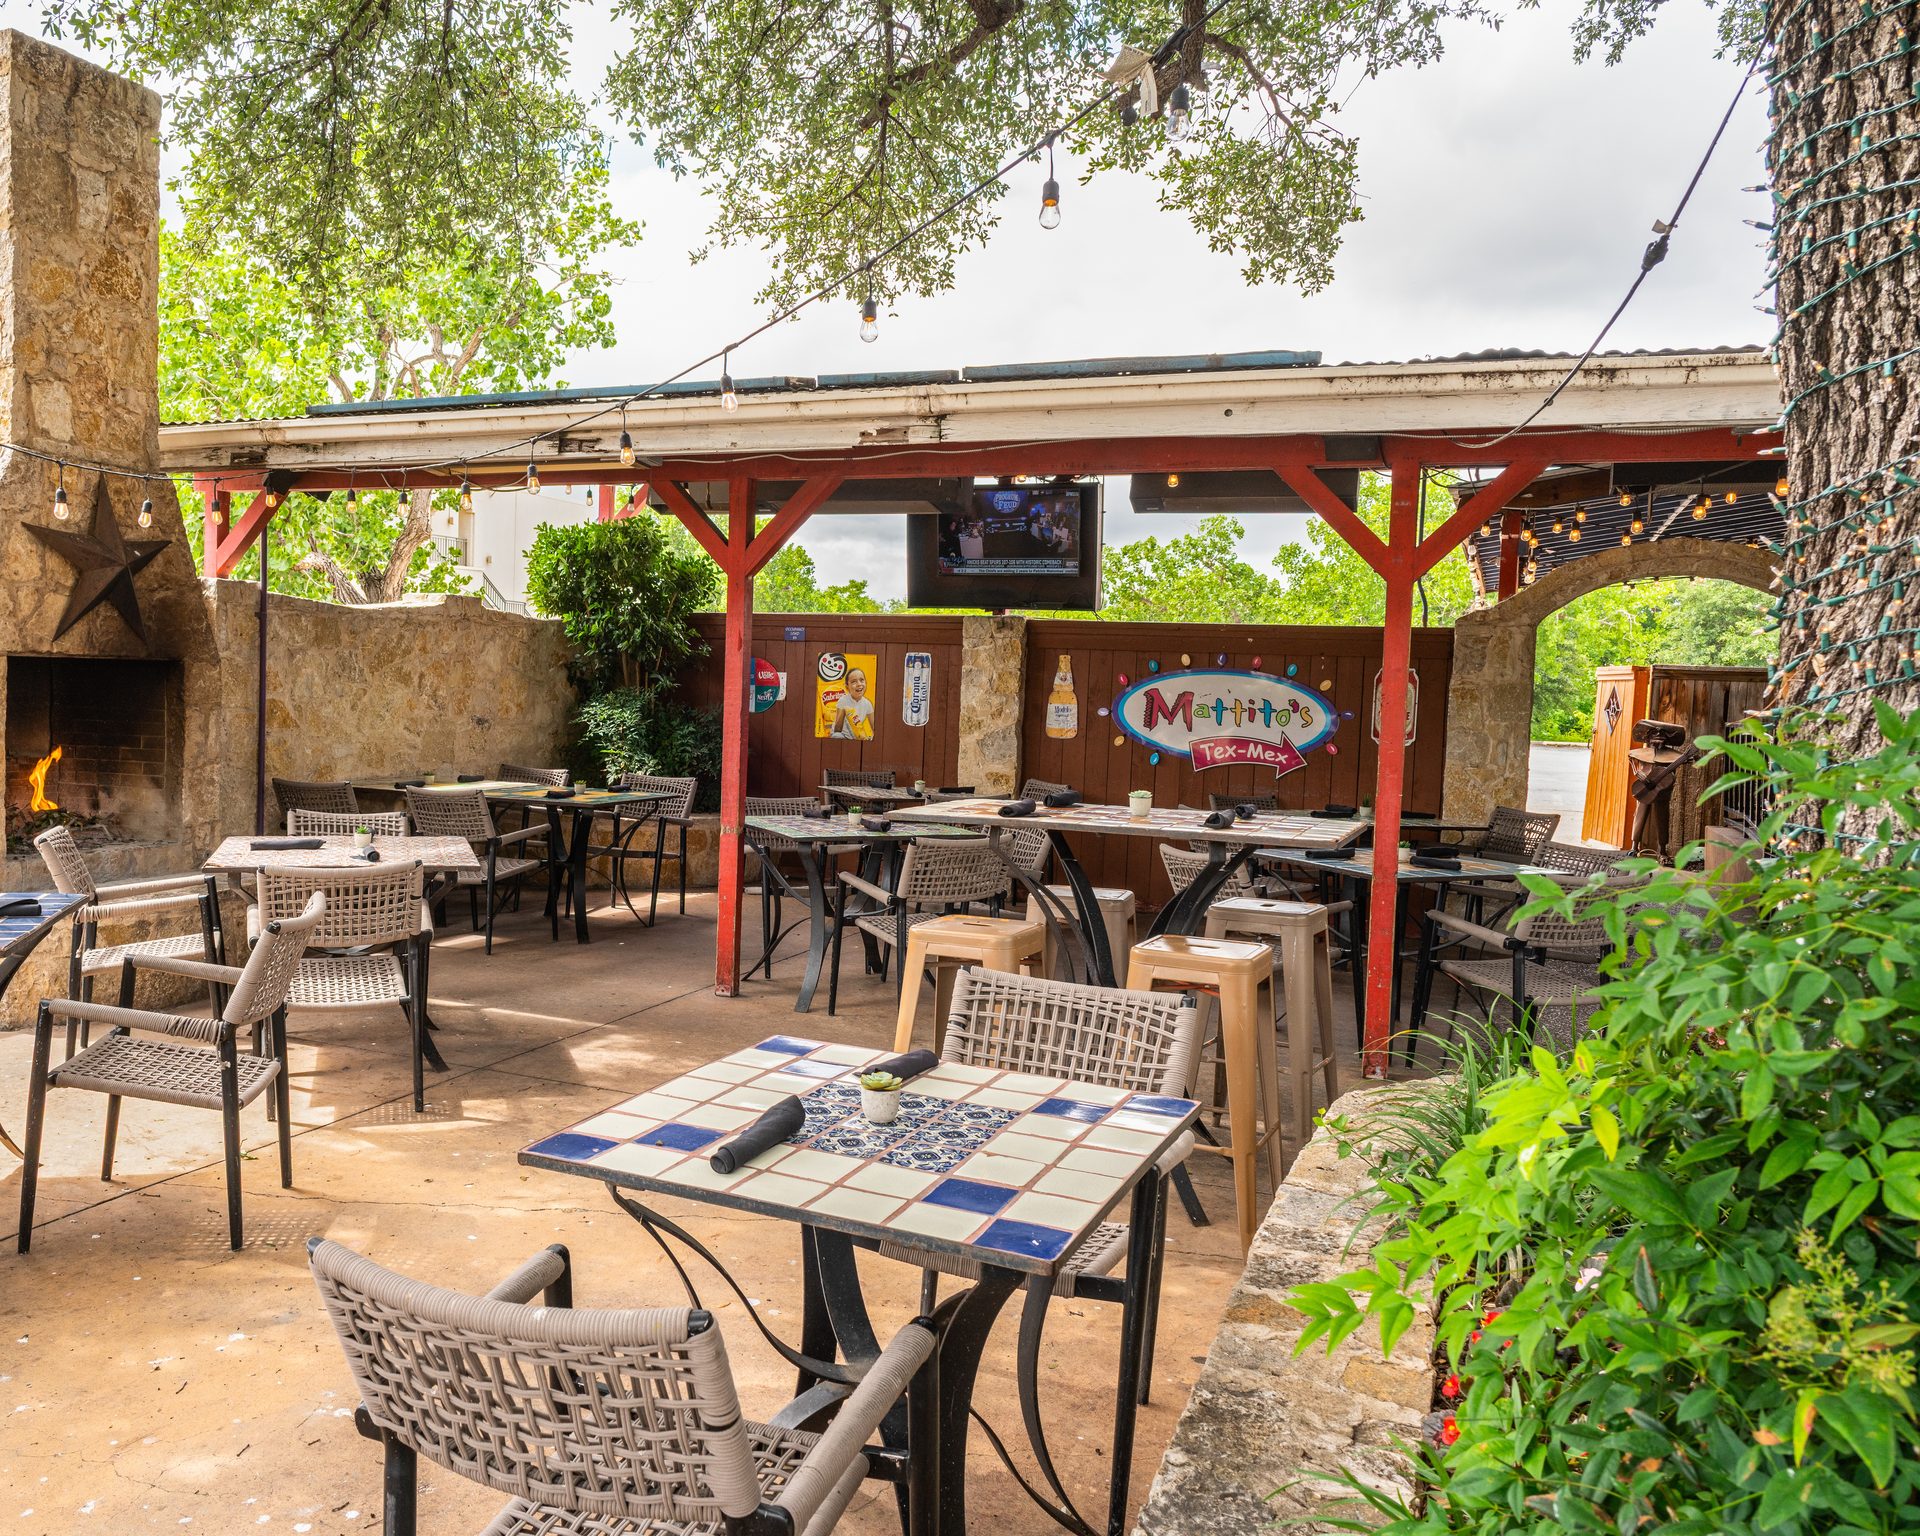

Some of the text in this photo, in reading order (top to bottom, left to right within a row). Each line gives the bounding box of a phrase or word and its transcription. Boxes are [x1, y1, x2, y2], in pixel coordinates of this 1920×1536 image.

[998, 501, 1017, 510] FEUD
[911, 676, 921, 714] Corona
[1143, 688, 1313, 732] Mattito's
[1200, 742, 1289, 764] Tex-Mex
